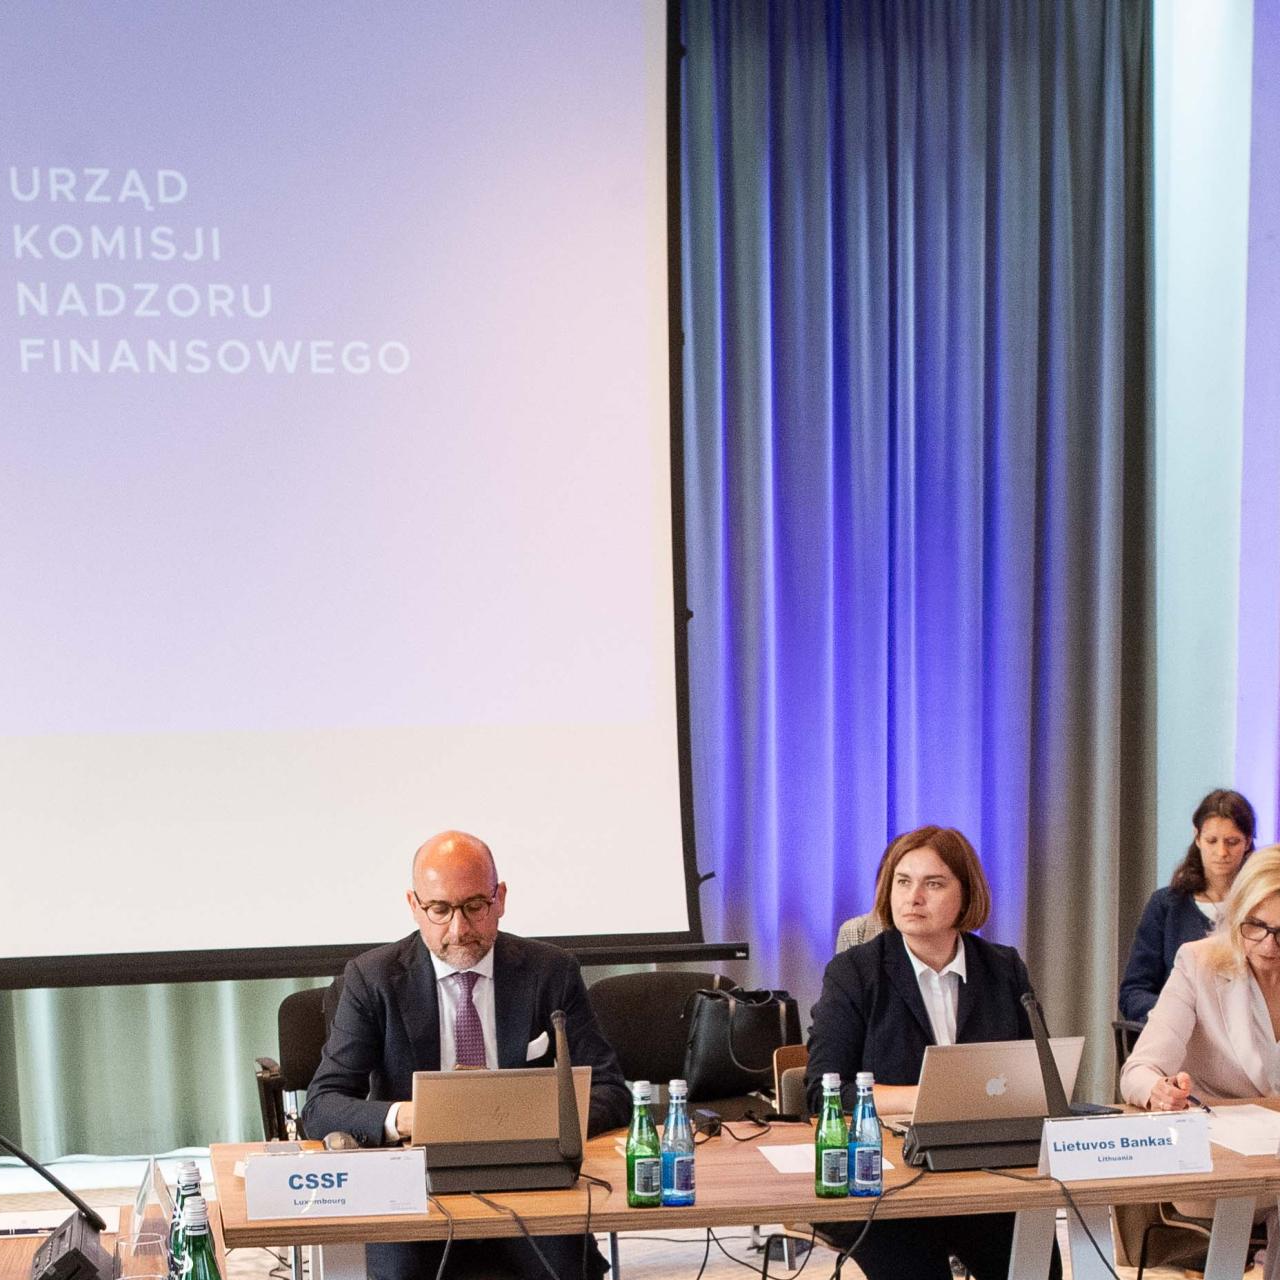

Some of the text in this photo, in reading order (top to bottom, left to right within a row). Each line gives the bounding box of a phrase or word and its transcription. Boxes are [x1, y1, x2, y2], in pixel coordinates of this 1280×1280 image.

[8, 166, 189, 212] URZĄD
[11, 222, 223, 263] KOMISJI
[15, 280, 274, 321] NADZORU
[18, 337, 413, 377] FINANSOWEGO
[1053, 1135, 1173, 1152] Lietuvos Bankas
[288, 1172, 349, 1190] CSSF
[293, 1197, 346, 1206] Luxmbourg
